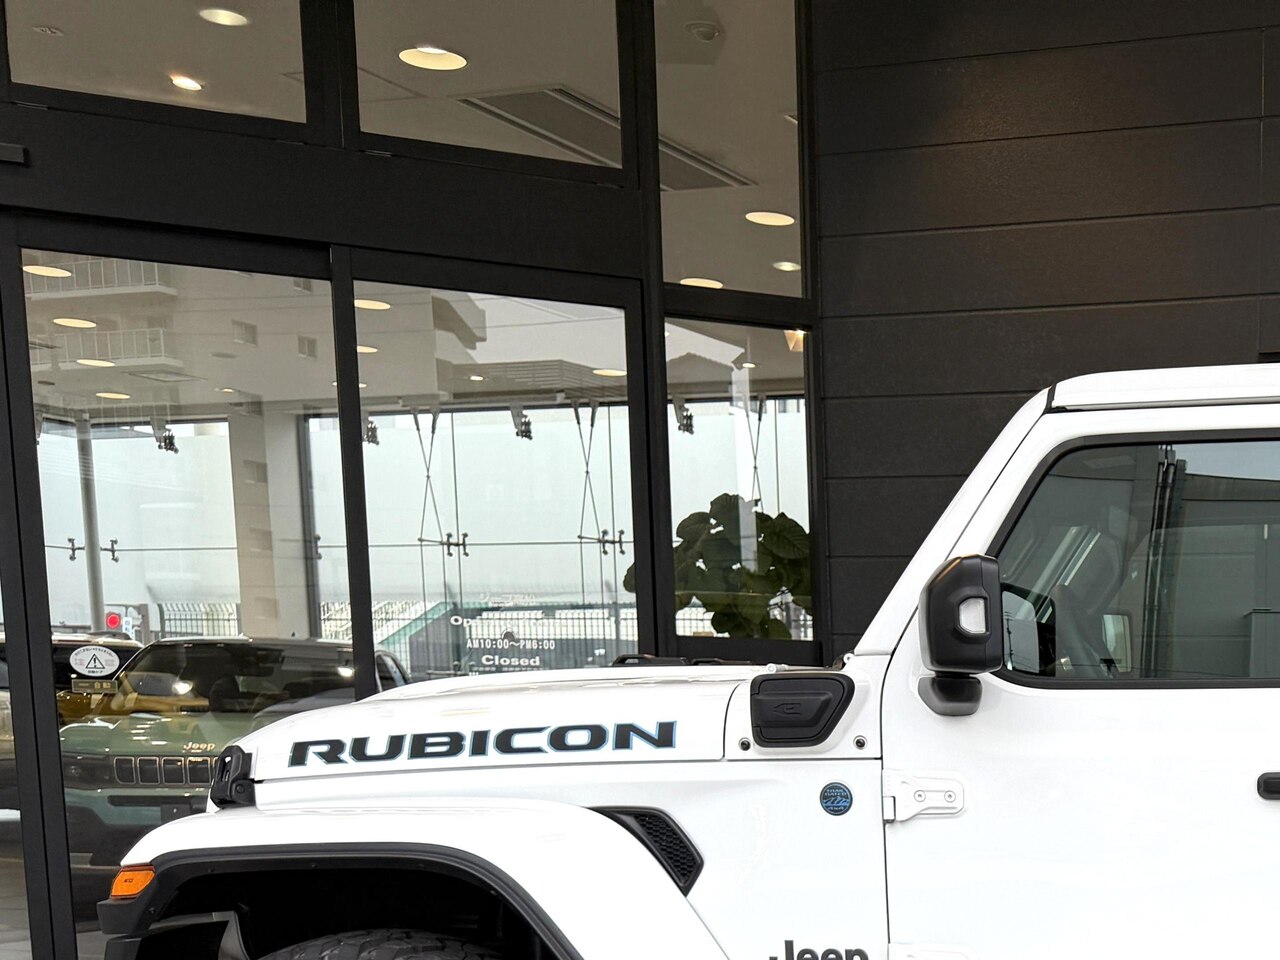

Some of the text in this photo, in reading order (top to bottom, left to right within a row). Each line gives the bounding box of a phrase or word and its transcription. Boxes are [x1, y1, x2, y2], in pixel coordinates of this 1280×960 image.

[481, 655, 541, 666] Closed
[183, 741, 216, 751] Jeep
[288, 720, 677, 768] RUBICON
